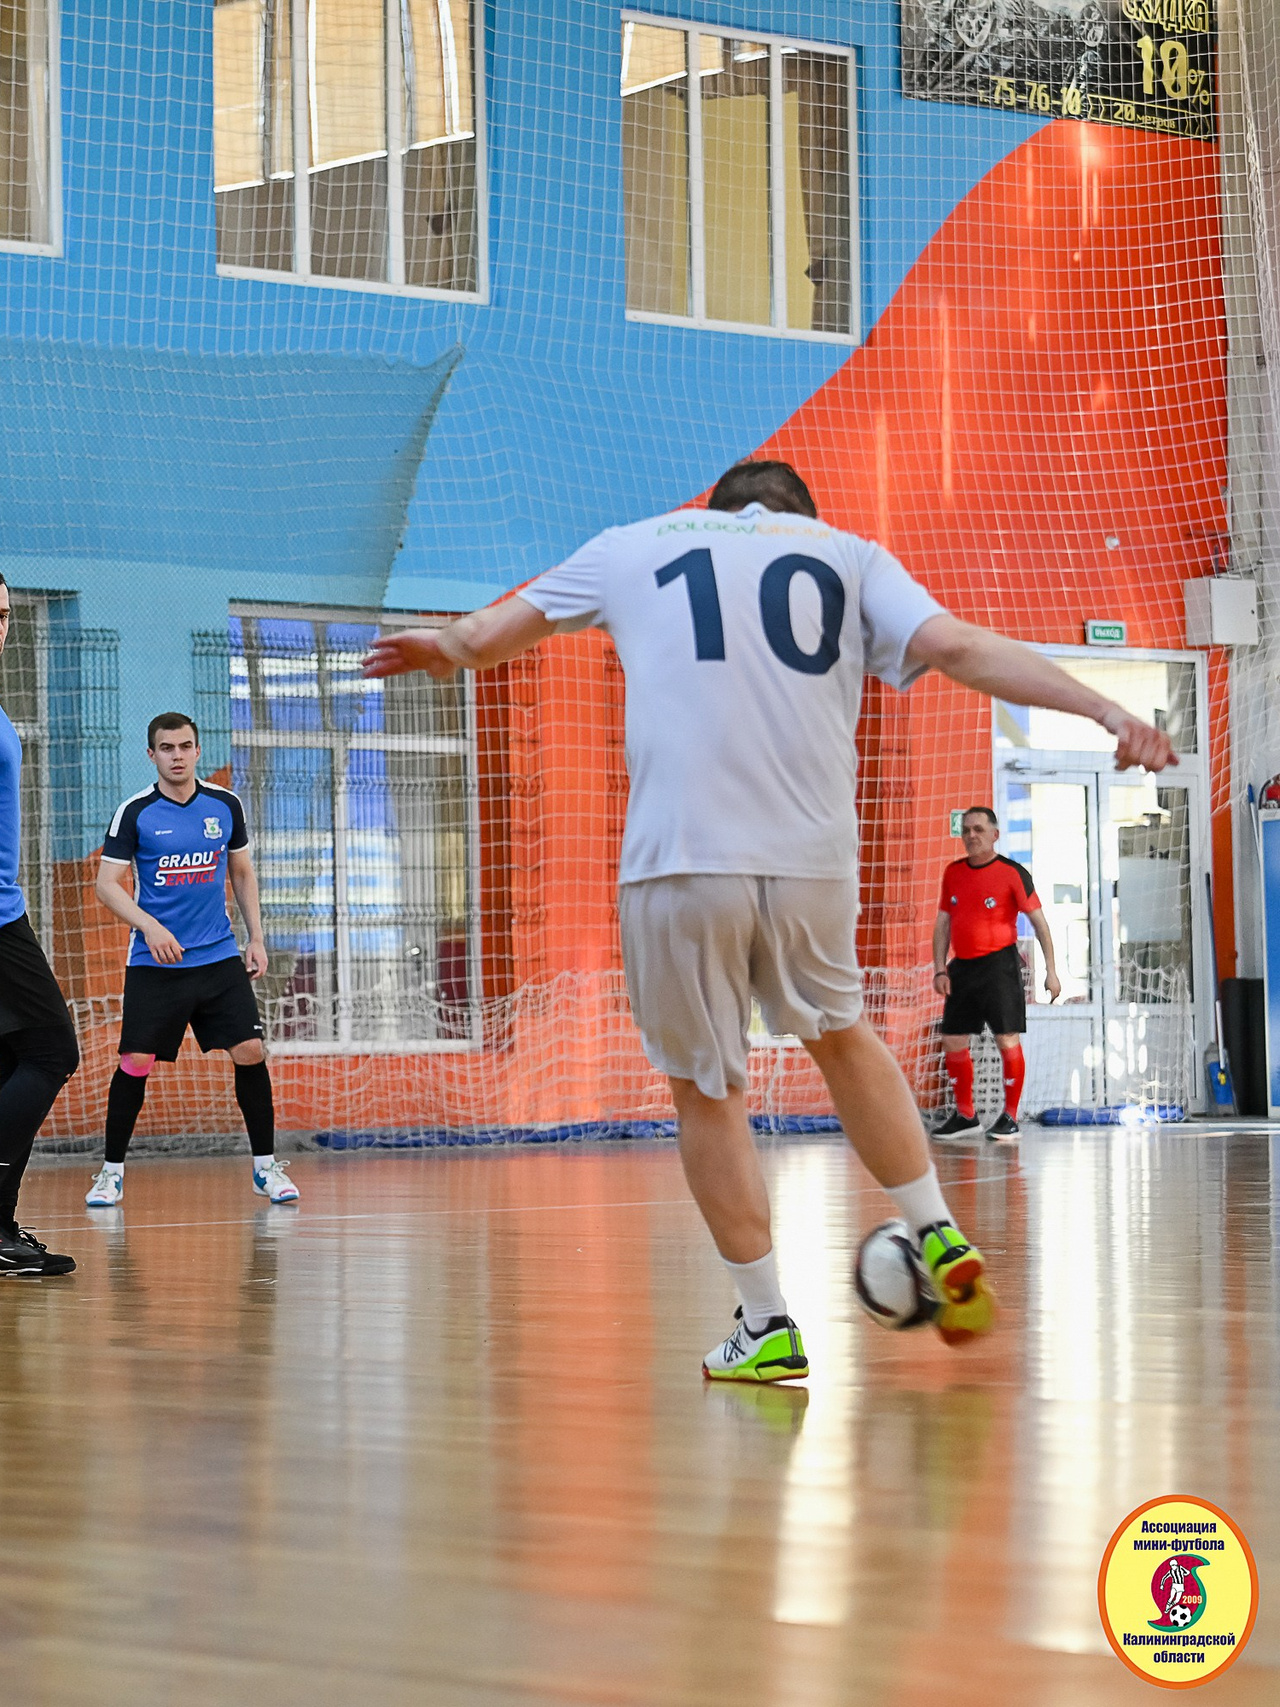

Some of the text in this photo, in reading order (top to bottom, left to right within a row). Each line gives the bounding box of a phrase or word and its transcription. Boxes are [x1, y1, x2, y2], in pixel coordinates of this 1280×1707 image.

[1113, 102, 1135, 121] 20
[654, 547, 845, 675] 10
[158, 850, 222, 868] GRADUS
[154, 869, 217, 887] SERVICE
